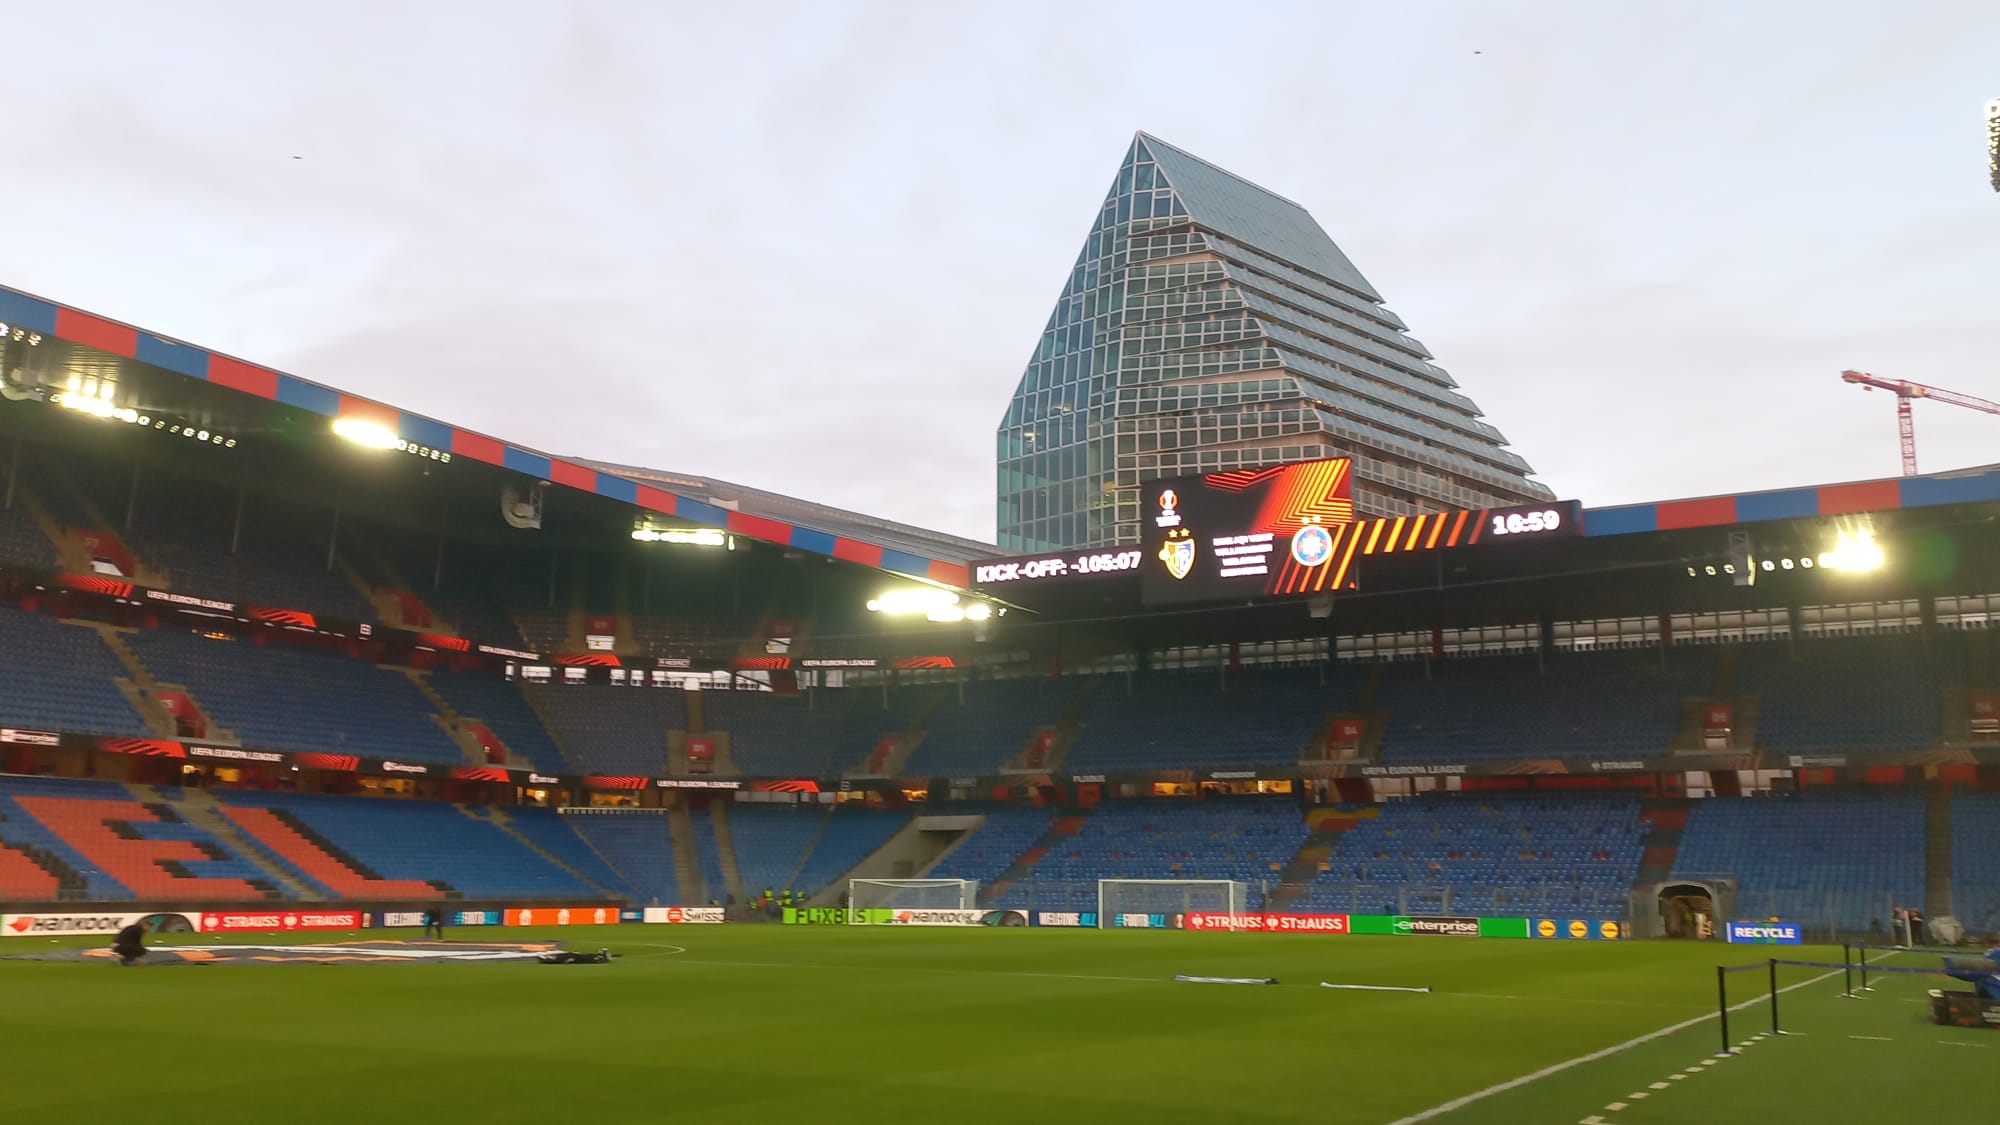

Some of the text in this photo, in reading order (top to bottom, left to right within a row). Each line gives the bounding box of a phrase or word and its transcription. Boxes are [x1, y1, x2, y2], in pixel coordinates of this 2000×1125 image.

[1493, 510, 1560, 535] 16:59
[976, 551, 1142, 583] KICK-OFF: -105:07
[1362, 766, 1388, 775] UEFA
[223, 915, 353, 927] STRAUSS STRAUSS
[1205, 915, 1343, 929] STRAUSS STRAUSS
[1395, 920, 1478, 934] enterprise
[1735, 927, 1796, 938] RECYCLE
